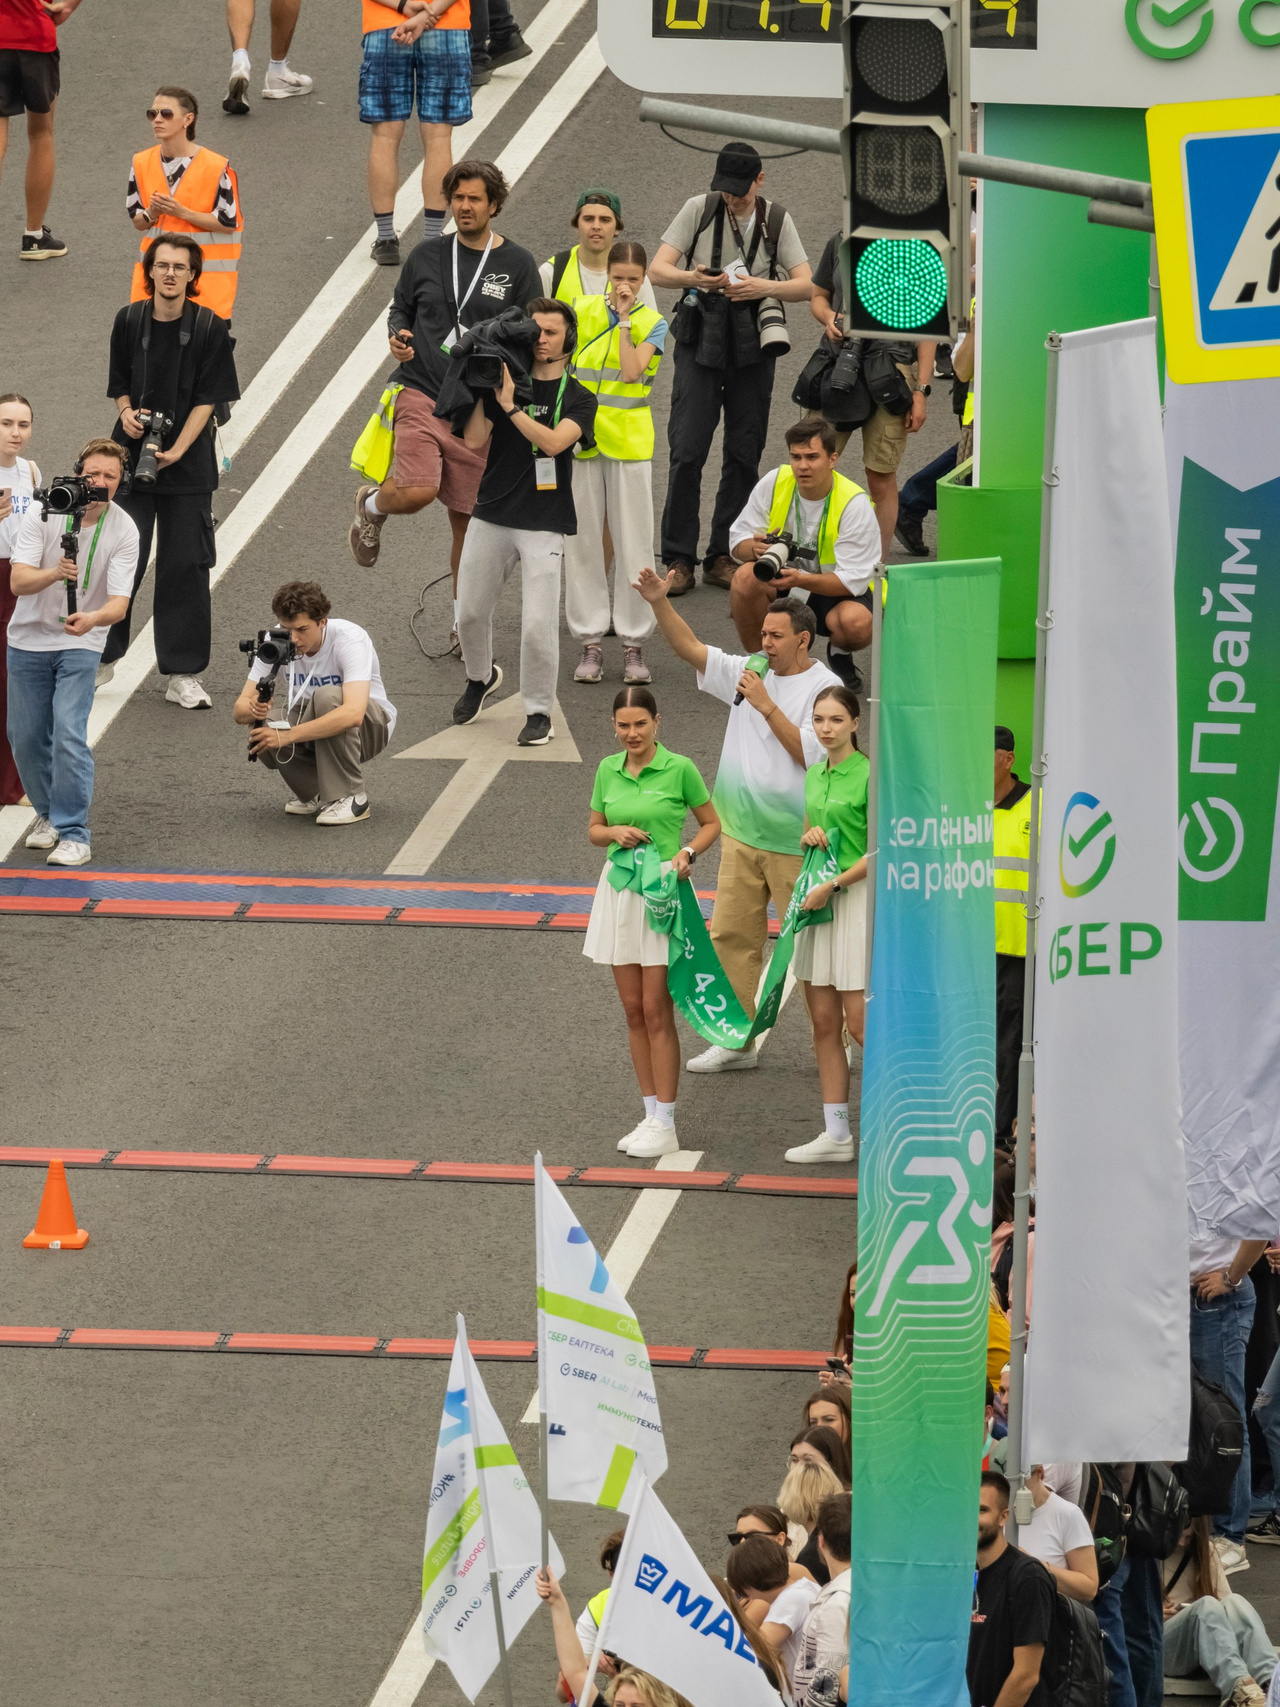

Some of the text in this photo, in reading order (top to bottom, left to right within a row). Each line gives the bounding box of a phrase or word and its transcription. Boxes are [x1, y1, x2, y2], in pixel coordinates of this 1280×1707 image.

[1190, 527, 1261, 774] Прайм
[695, 973, 727, 1021] 4,2
[571, 1367, 598, 1382] SBER
[661, 1579, 762, 1669] МАЕ
